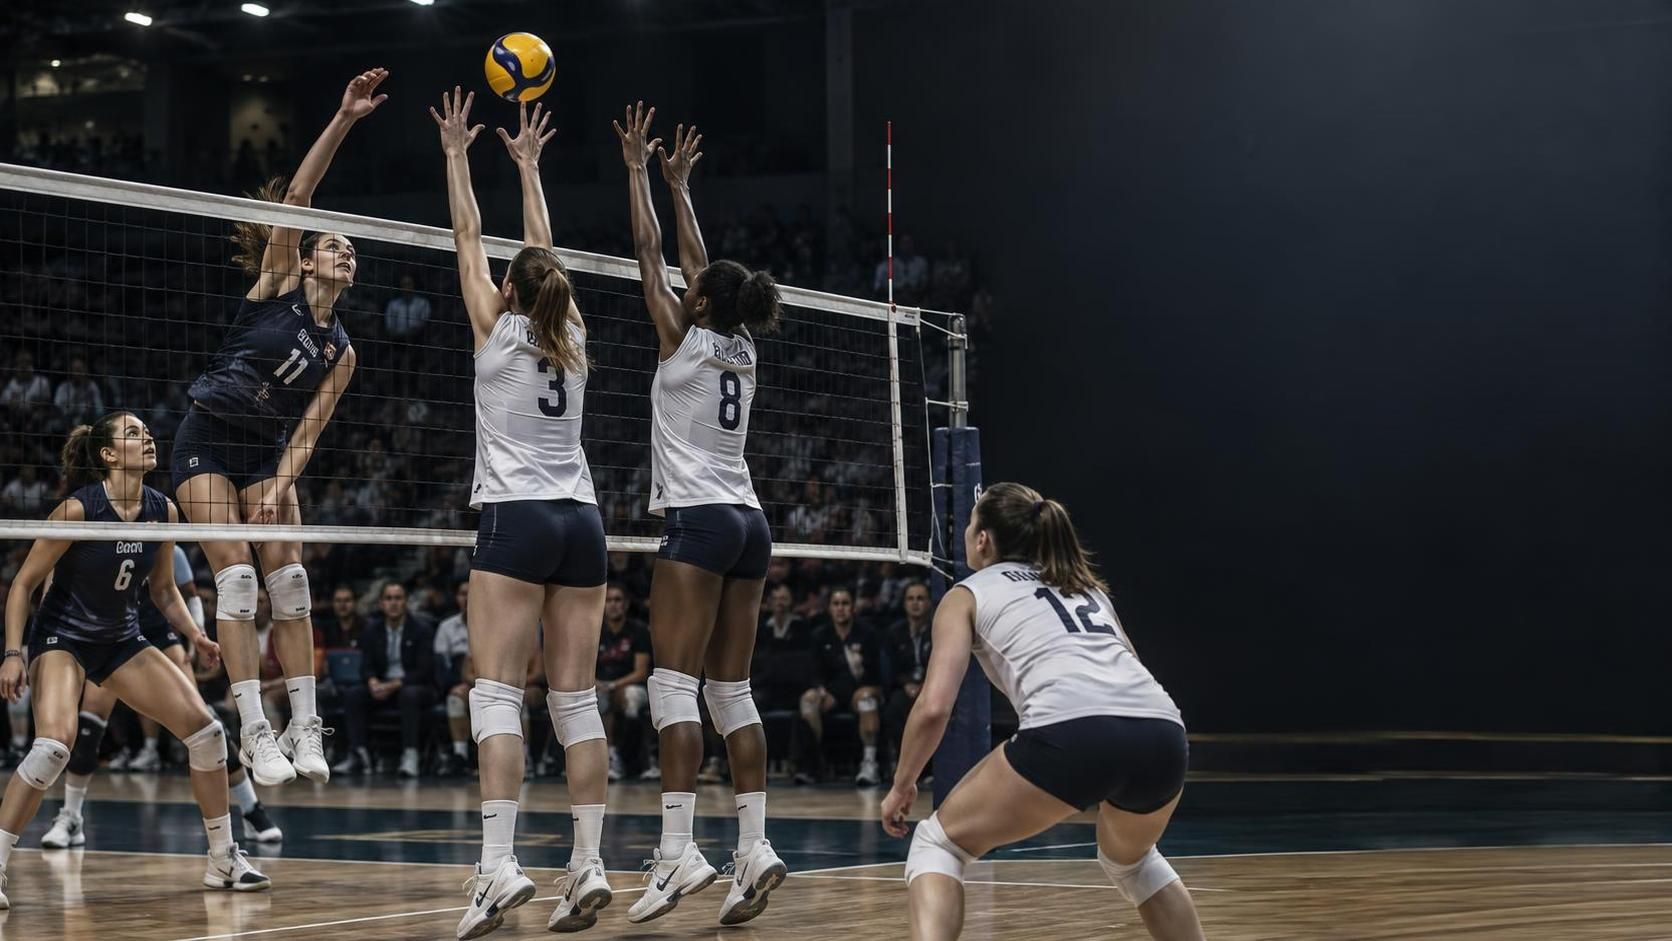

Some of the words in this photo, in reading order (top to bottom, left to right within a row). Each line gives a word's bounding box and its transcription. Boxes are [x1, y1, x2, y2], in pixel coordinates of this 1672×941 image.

[273, 348, 309, 385] 11
[538, 356, 567, 417] 3
[720, 370, 741, 430] 8
[114, 559, 135, 590] 6
[1033, 587, 1117, 636] 12
